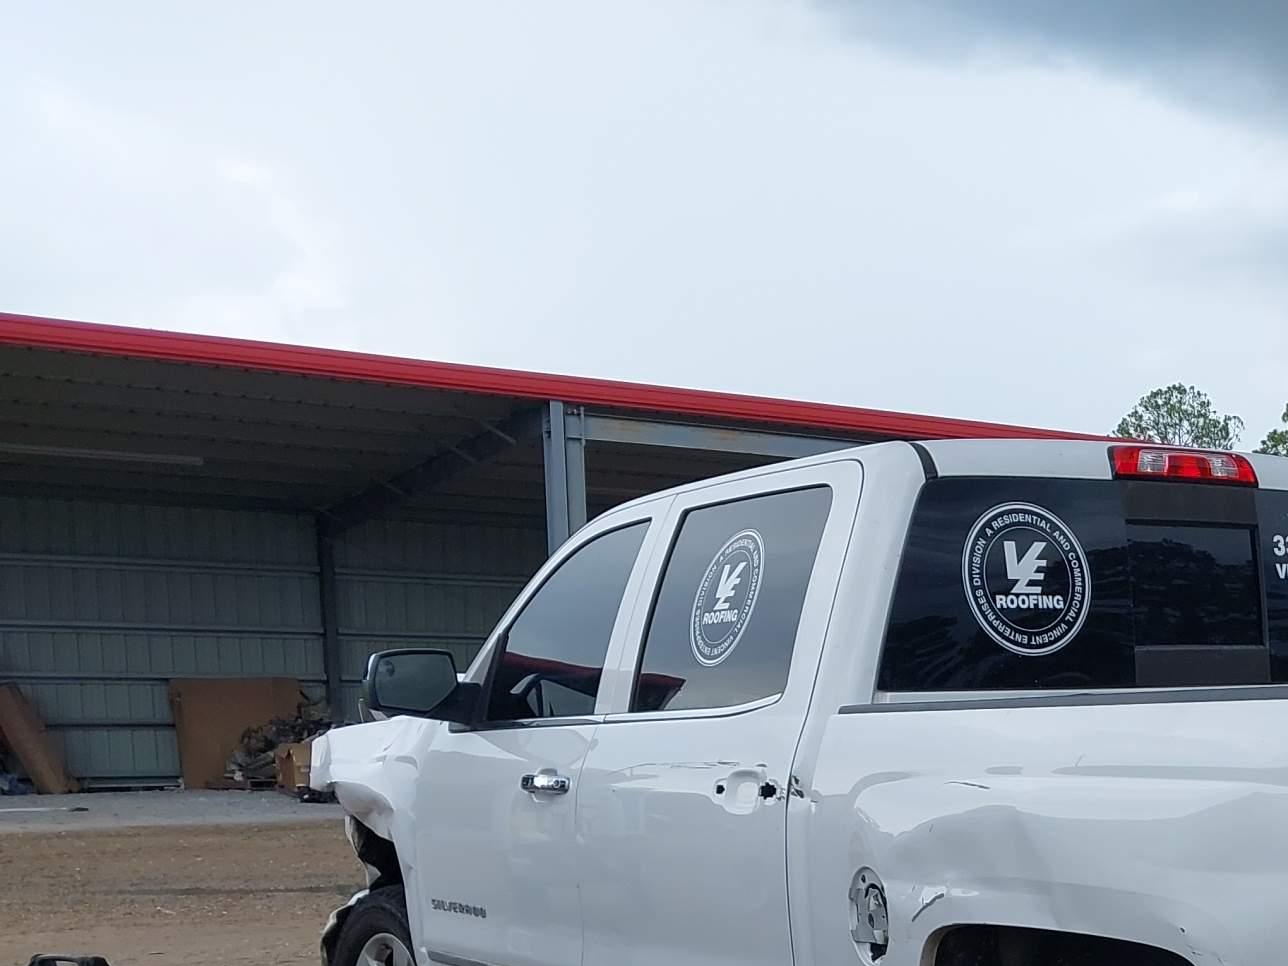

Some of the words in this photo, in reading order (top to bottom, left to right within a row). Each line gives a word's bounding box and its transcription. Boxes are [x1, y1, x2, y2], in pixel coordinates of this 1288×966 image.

[971, 537, 987, 586] DIVISION
[985, 527, 994, 537] A
[991, 513, 1052, 533] RESIDENTIAL
[1053, 530, 1071, 551] AND
[1065, 552, 1083, 622] COMMERCIAL
[702, 609, 739, 625] ROOFING
[975, 589, 1027, 644] ENTERPRISES
[995, 595, 1065, 609] ROOFING
[1030, 622, 1068, 645] VINCENT
